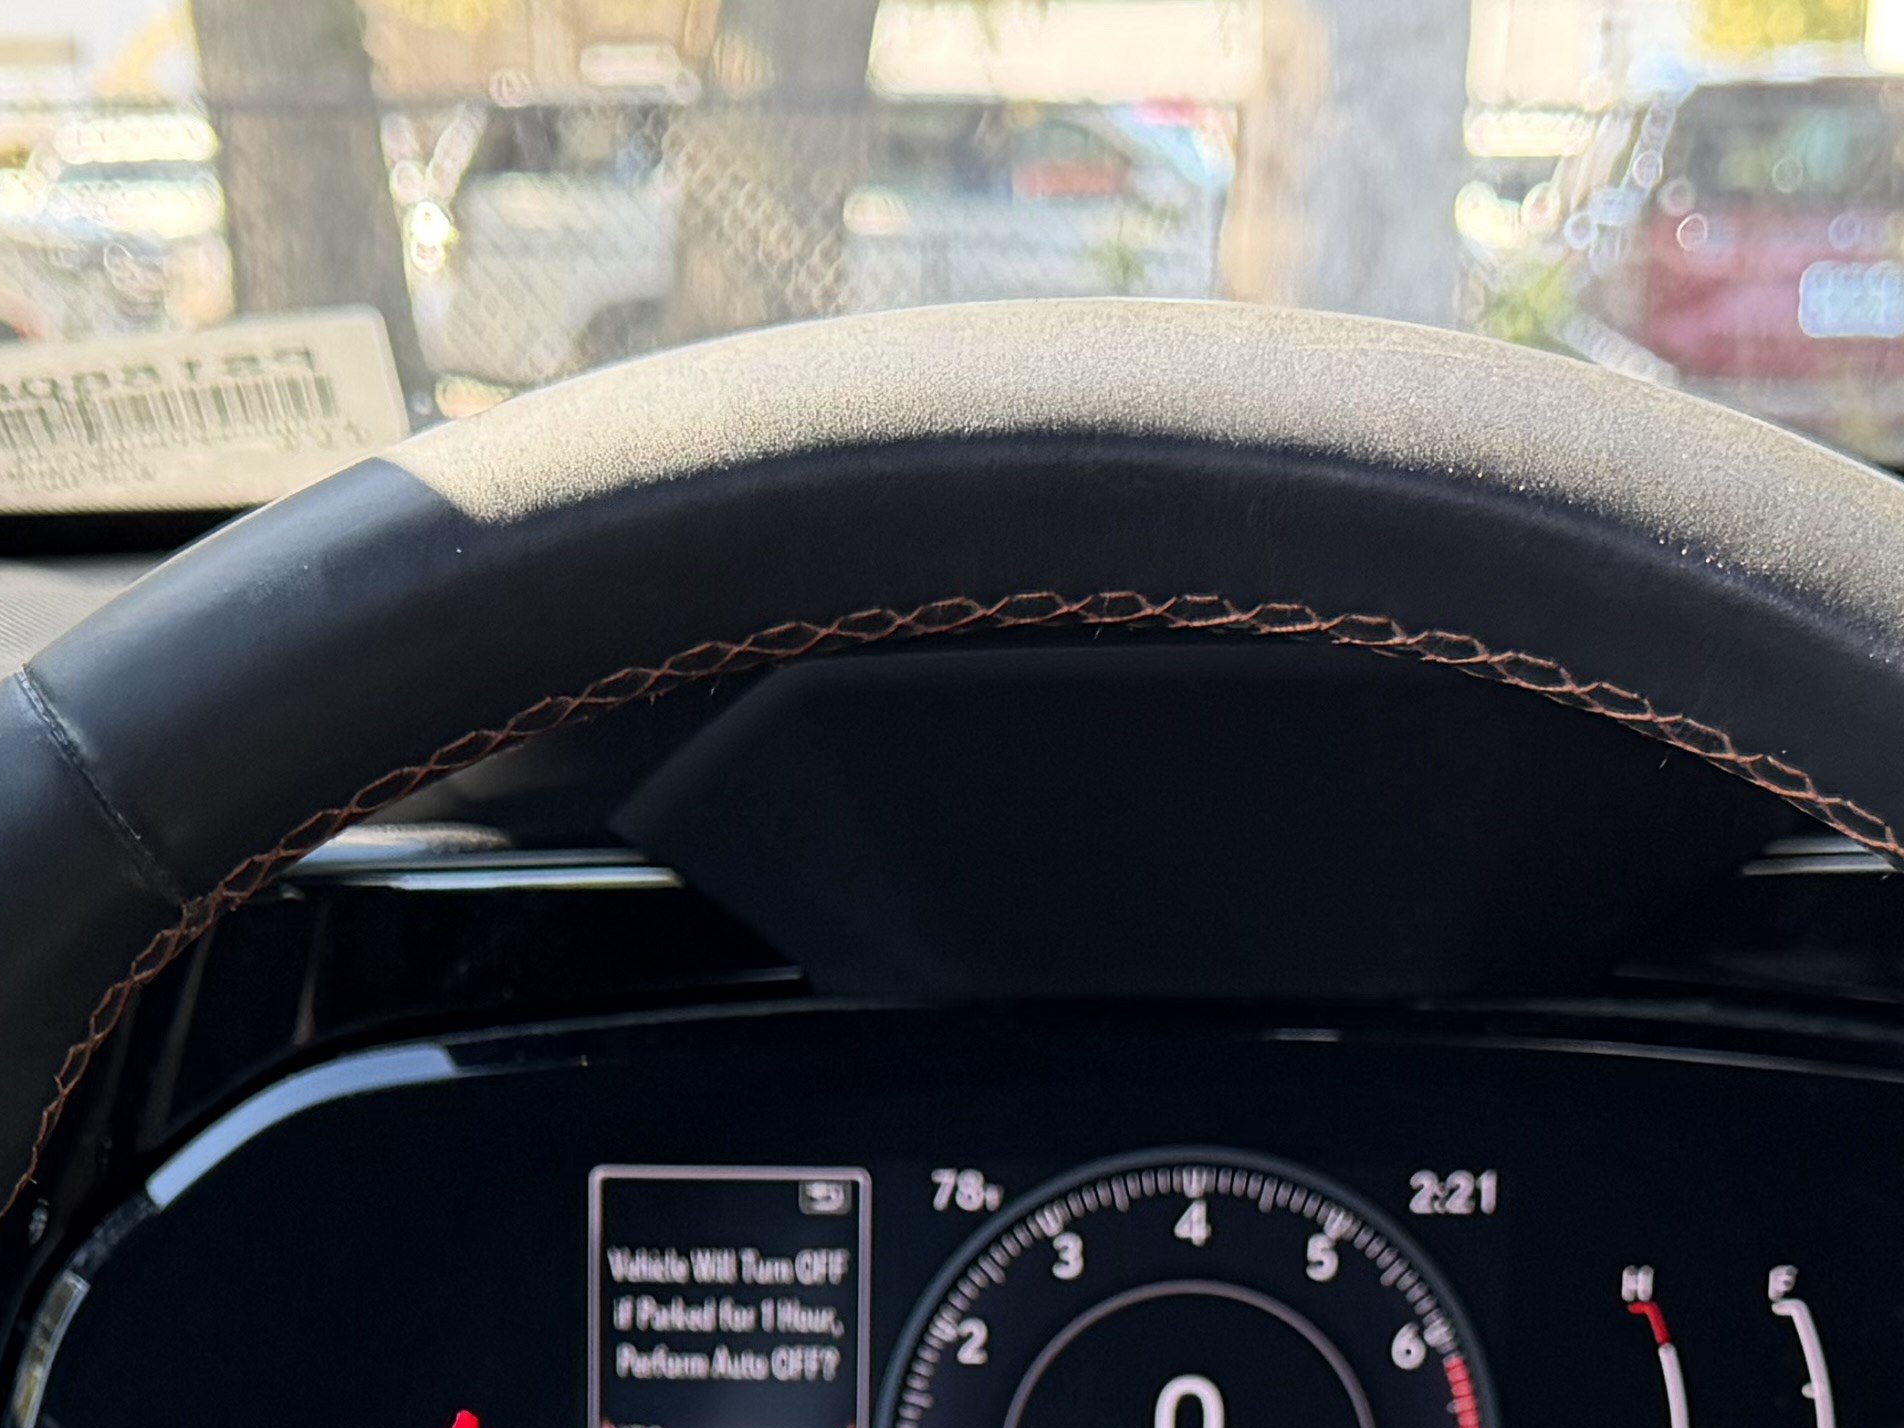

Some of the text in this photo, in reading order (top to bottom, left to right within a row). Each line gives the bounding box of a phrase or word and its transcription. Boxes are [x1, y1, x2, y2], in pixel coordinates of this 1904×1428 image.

[1408, 1169, 1499, 1215] 2:21
[1174, 1199, 1211, 1247] 4
[606, 1247, 850, 1286] Vehicle Will Turn OFF
[1052, 1231, 1084, 1280] 3
[1306, 1233, 1339, 1282] 5
[636, 1295, 716, 1332] Parked
[616, 1342, 841, 1381] Perform Auto OFF?
[956, 1317, 988, 1365] 2
[1391, 1321, 1427, 1370] 6
